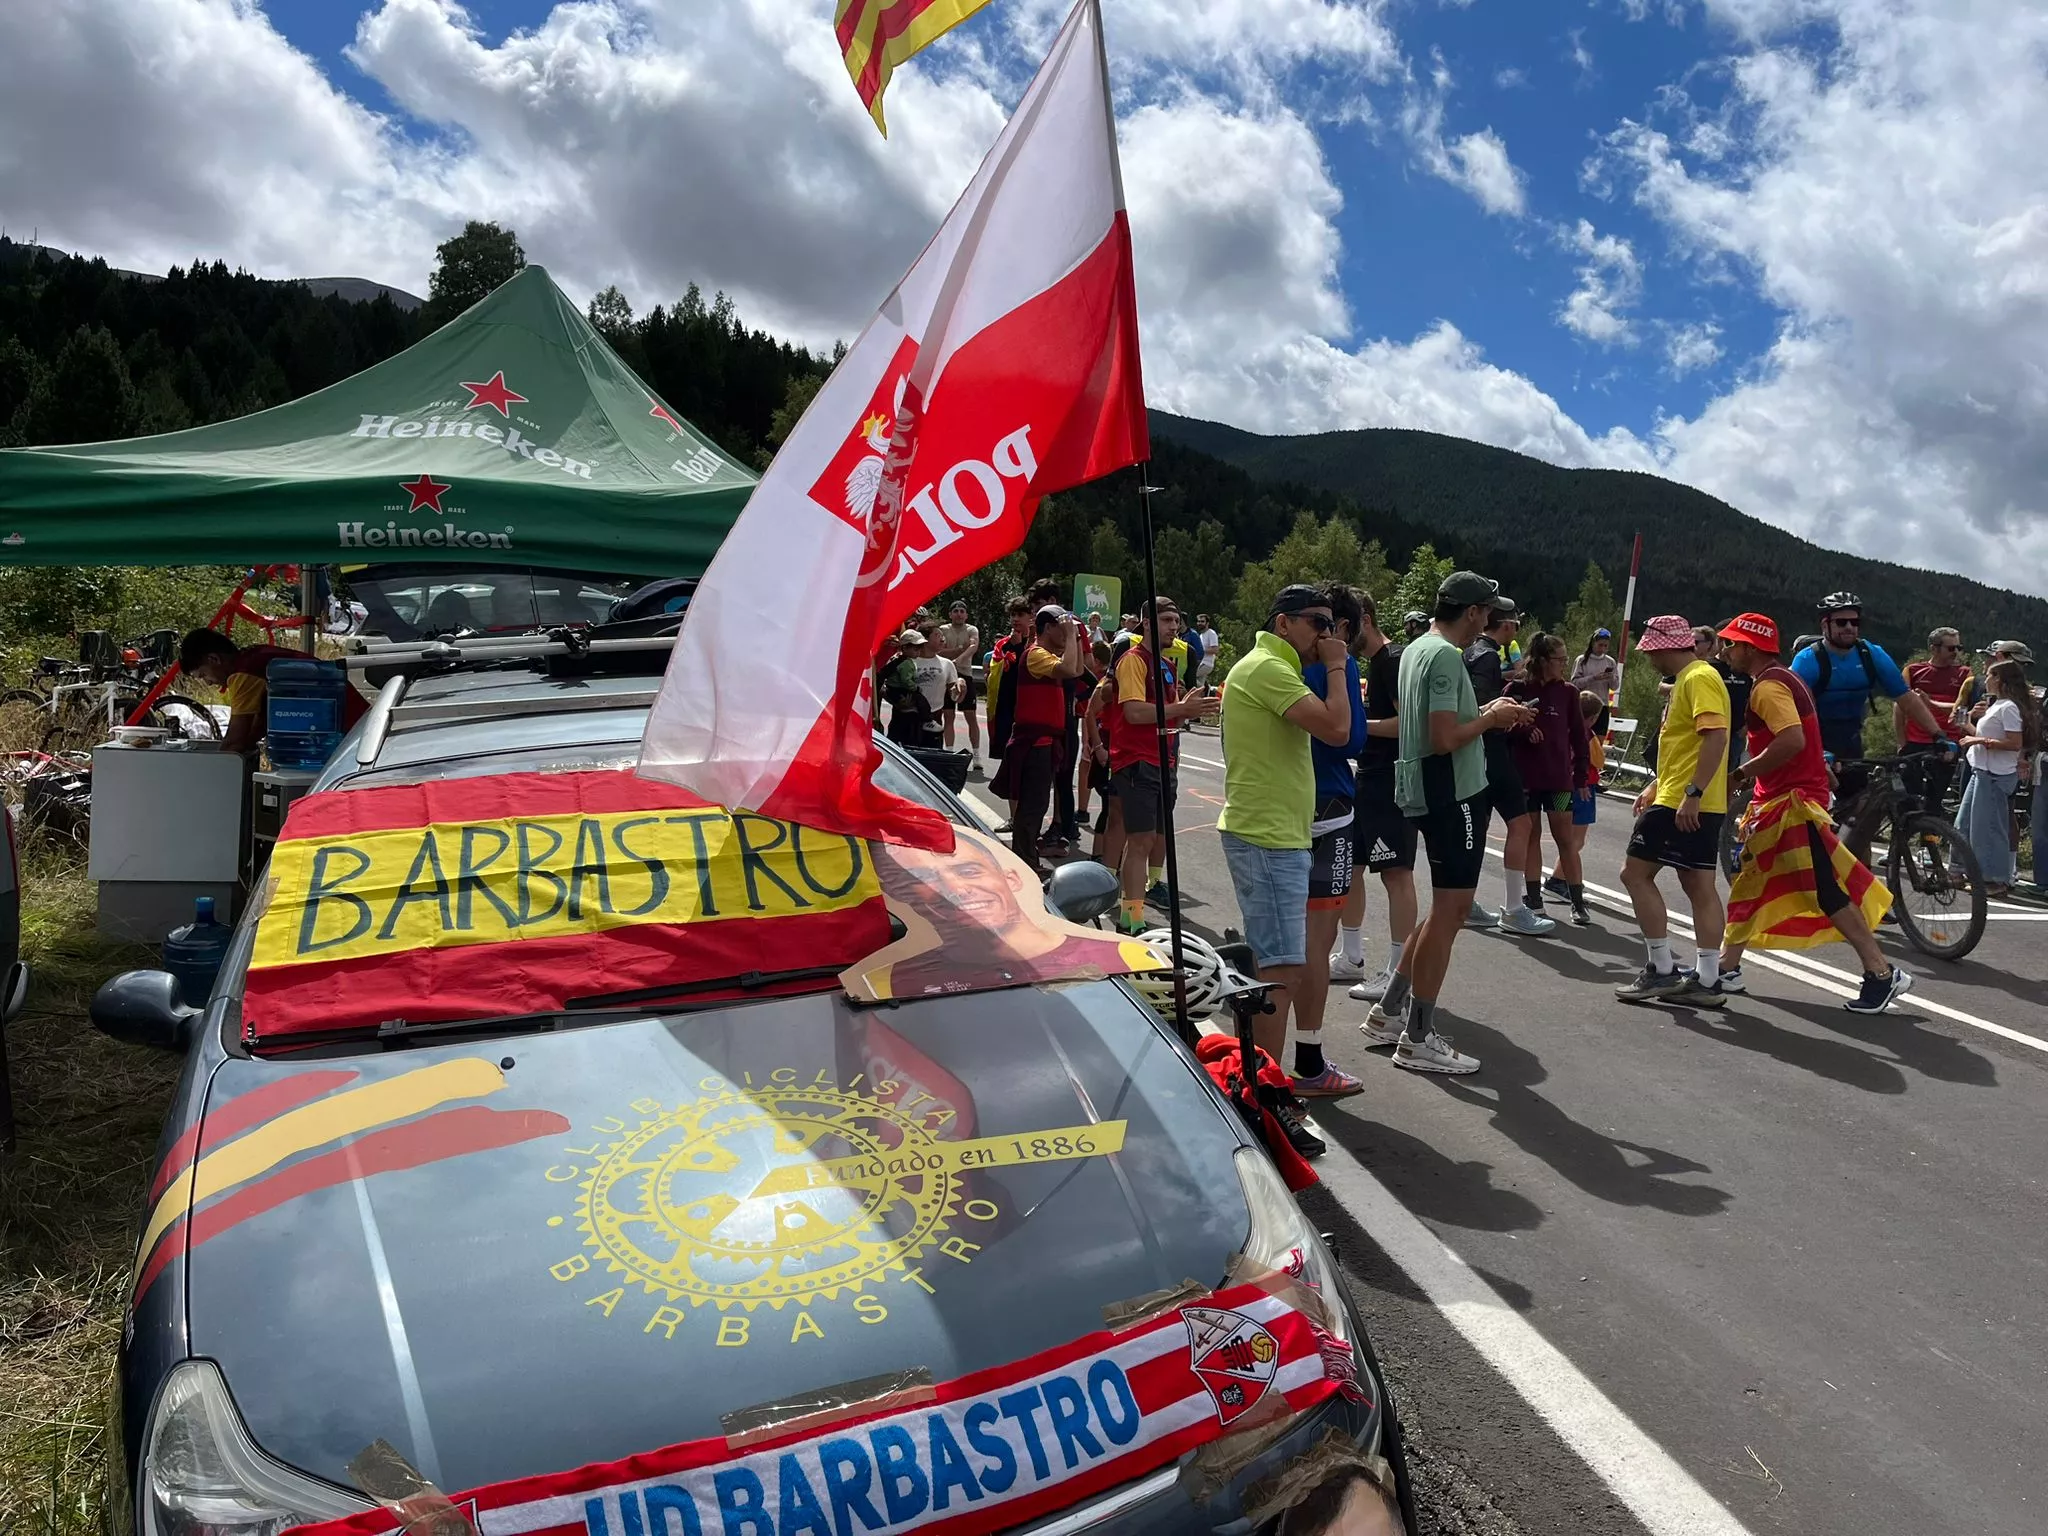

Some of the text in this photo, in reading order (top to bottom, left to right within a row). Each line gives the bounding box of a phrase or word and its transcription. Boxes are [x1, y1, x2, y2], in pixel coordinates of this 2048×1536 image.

[1736, 618, 1774, 638] VELUX
[1369, 850, 1397, 863] adidas
[1460, 802, 1474, 850] SIROKO
[296, 812, 864, 955] BARBASTRO
[544, 1098, 662, 1182] CLUB
[699, 1067, 958, 1127] CICLISTA
[806, 1132, 1097, 1187] Fundado en 1886
[547, 1198, 1001, 1349] BARBASTRO
[713, 1357, 1141, 1536] BARBASTRO
